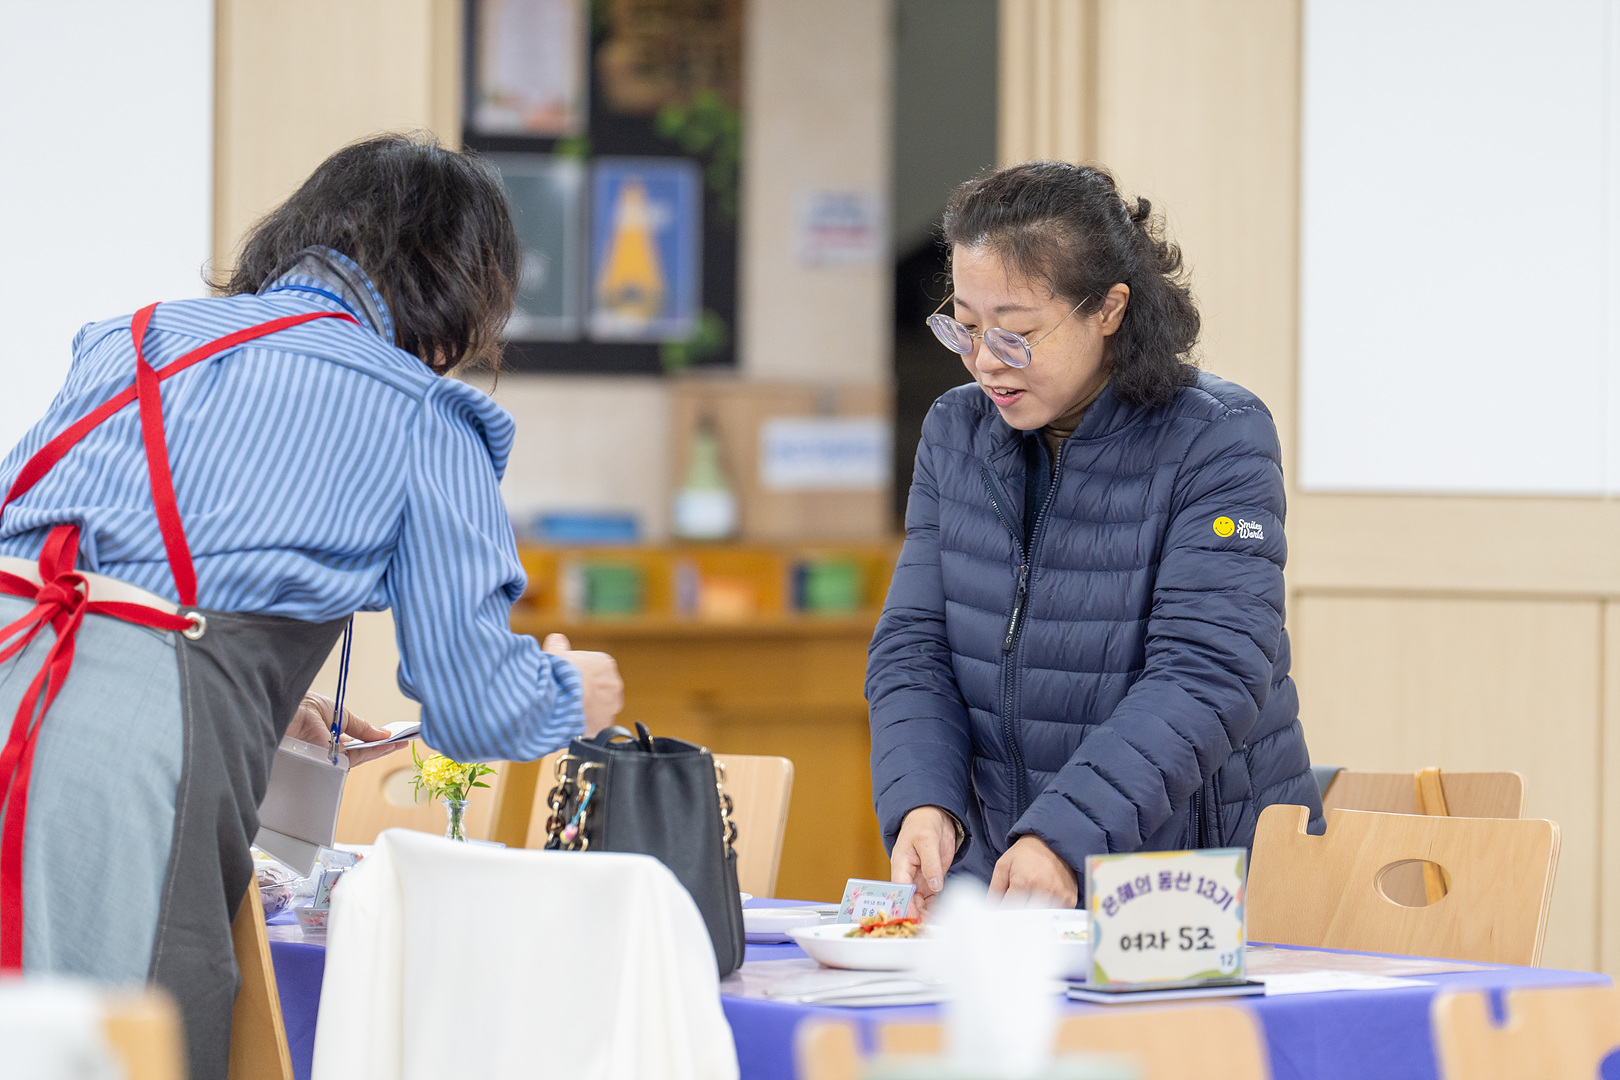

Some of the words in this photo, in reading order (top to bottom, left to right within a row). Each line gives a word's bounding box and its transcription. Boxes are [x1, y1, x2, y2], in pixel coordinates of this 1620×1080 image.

[1237, 519, 1263, 532] Smiley
[1236, 527, 1264, 540] World
[1101, 874, 1152, 918] 은혜의
[1157, 870, 1191, 892] 동산
[1195, 877, 1234, 912] 13기
[1119, 932, 1169, 951] 여자
[1178, 927, 1215, 951] 5조
[1220, 954, 1235, 967] 12
